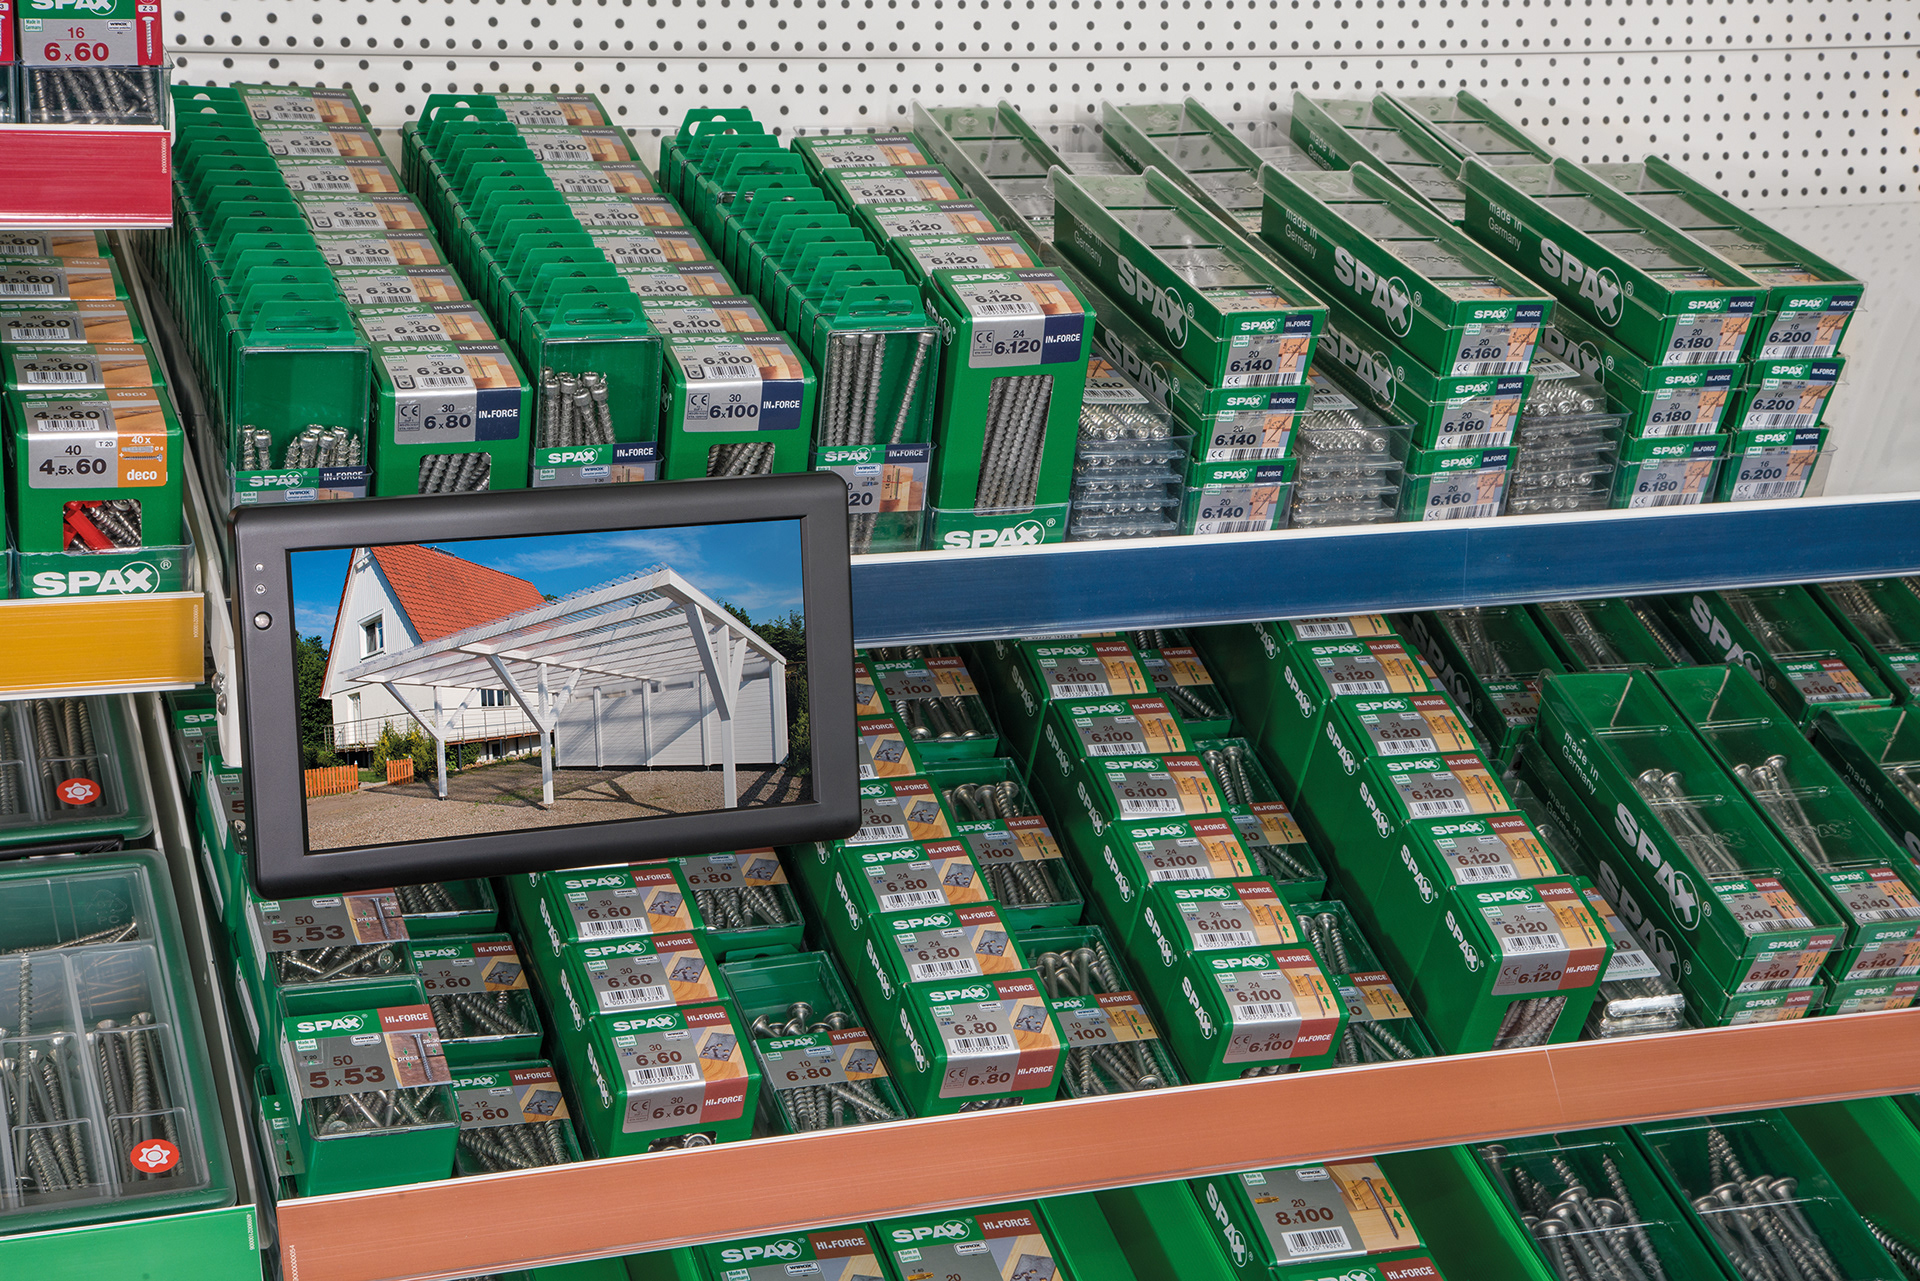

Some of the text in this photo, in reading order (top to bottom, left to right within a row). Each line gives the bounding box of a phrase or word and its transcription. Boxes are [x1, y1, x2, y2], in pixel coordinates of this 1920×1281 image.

[68, 27, 84, 38] 16
[812, 137, 869, 146] SPAX
[337, 268, 398, 277] SPAX
[951, 272, 1011, 282] SPAX
[1540, 238, 1623, 328] SPAX
[1334, 245, 1413, 337] SPAX
[1118, 254, 1188, 349] SPAX
[1688, 298, 1723, 311] SPAX
[1789, 297, 1824, 309] SPAX
[1474, 307, 1508, 321] SPAX
[1241, 318, 1277, 332] SPAX
[1013, 329, 1025, 338] 24
[383, 344, 448, 353] SPAX
[729, 393, 741, 402] 30
[441, 404, 455, 412] 30
[1755, 431, 1788, 444] SPAX
[65, 445, 81, 455] 40
[548, 448, 598, 464] SPAX
[825, 447, 871, 463] SPAX
[1441, 454, 1475, 468] SPAX
[127, 469, 157, 481] deco
[250, 471, 303, 488] SPAX
[1213, 468, 1249, 481] SPAX
[943, 520, 1044, 550] SPAX
[33, 561, 160, 595] SPAX
[1104, 759, 1158, 771] SPAX
[1387, 758, 1440, 771] SPAX
[1616, 803, 1701, 931] SPAX
[565, 875, 625, 889] SPAX
[1477, 887, 1532, 902] SPAX
[295, 916, 314, 925] 50
[1768, 939, 1803, 950] SPAX
[413, 946, 460, 959] SPAX
[1212, 954, 1269, 969] SPAX
[930, 985, 989, 1001] SPAX
[297, 1015, 364, 1032] SPAX
[613, 1014, 676, 1031] SPAX
[770, 1035, 818, 1048] SPAX
[333, 1055, 353, 1066] 50
[670, 1097, 683, 1105] 30
[1291, 1199, 1306, 1208] 20
[892, 1220, 969, 1242] SPAX
[721, 1239, 801, 1263] SPAX
